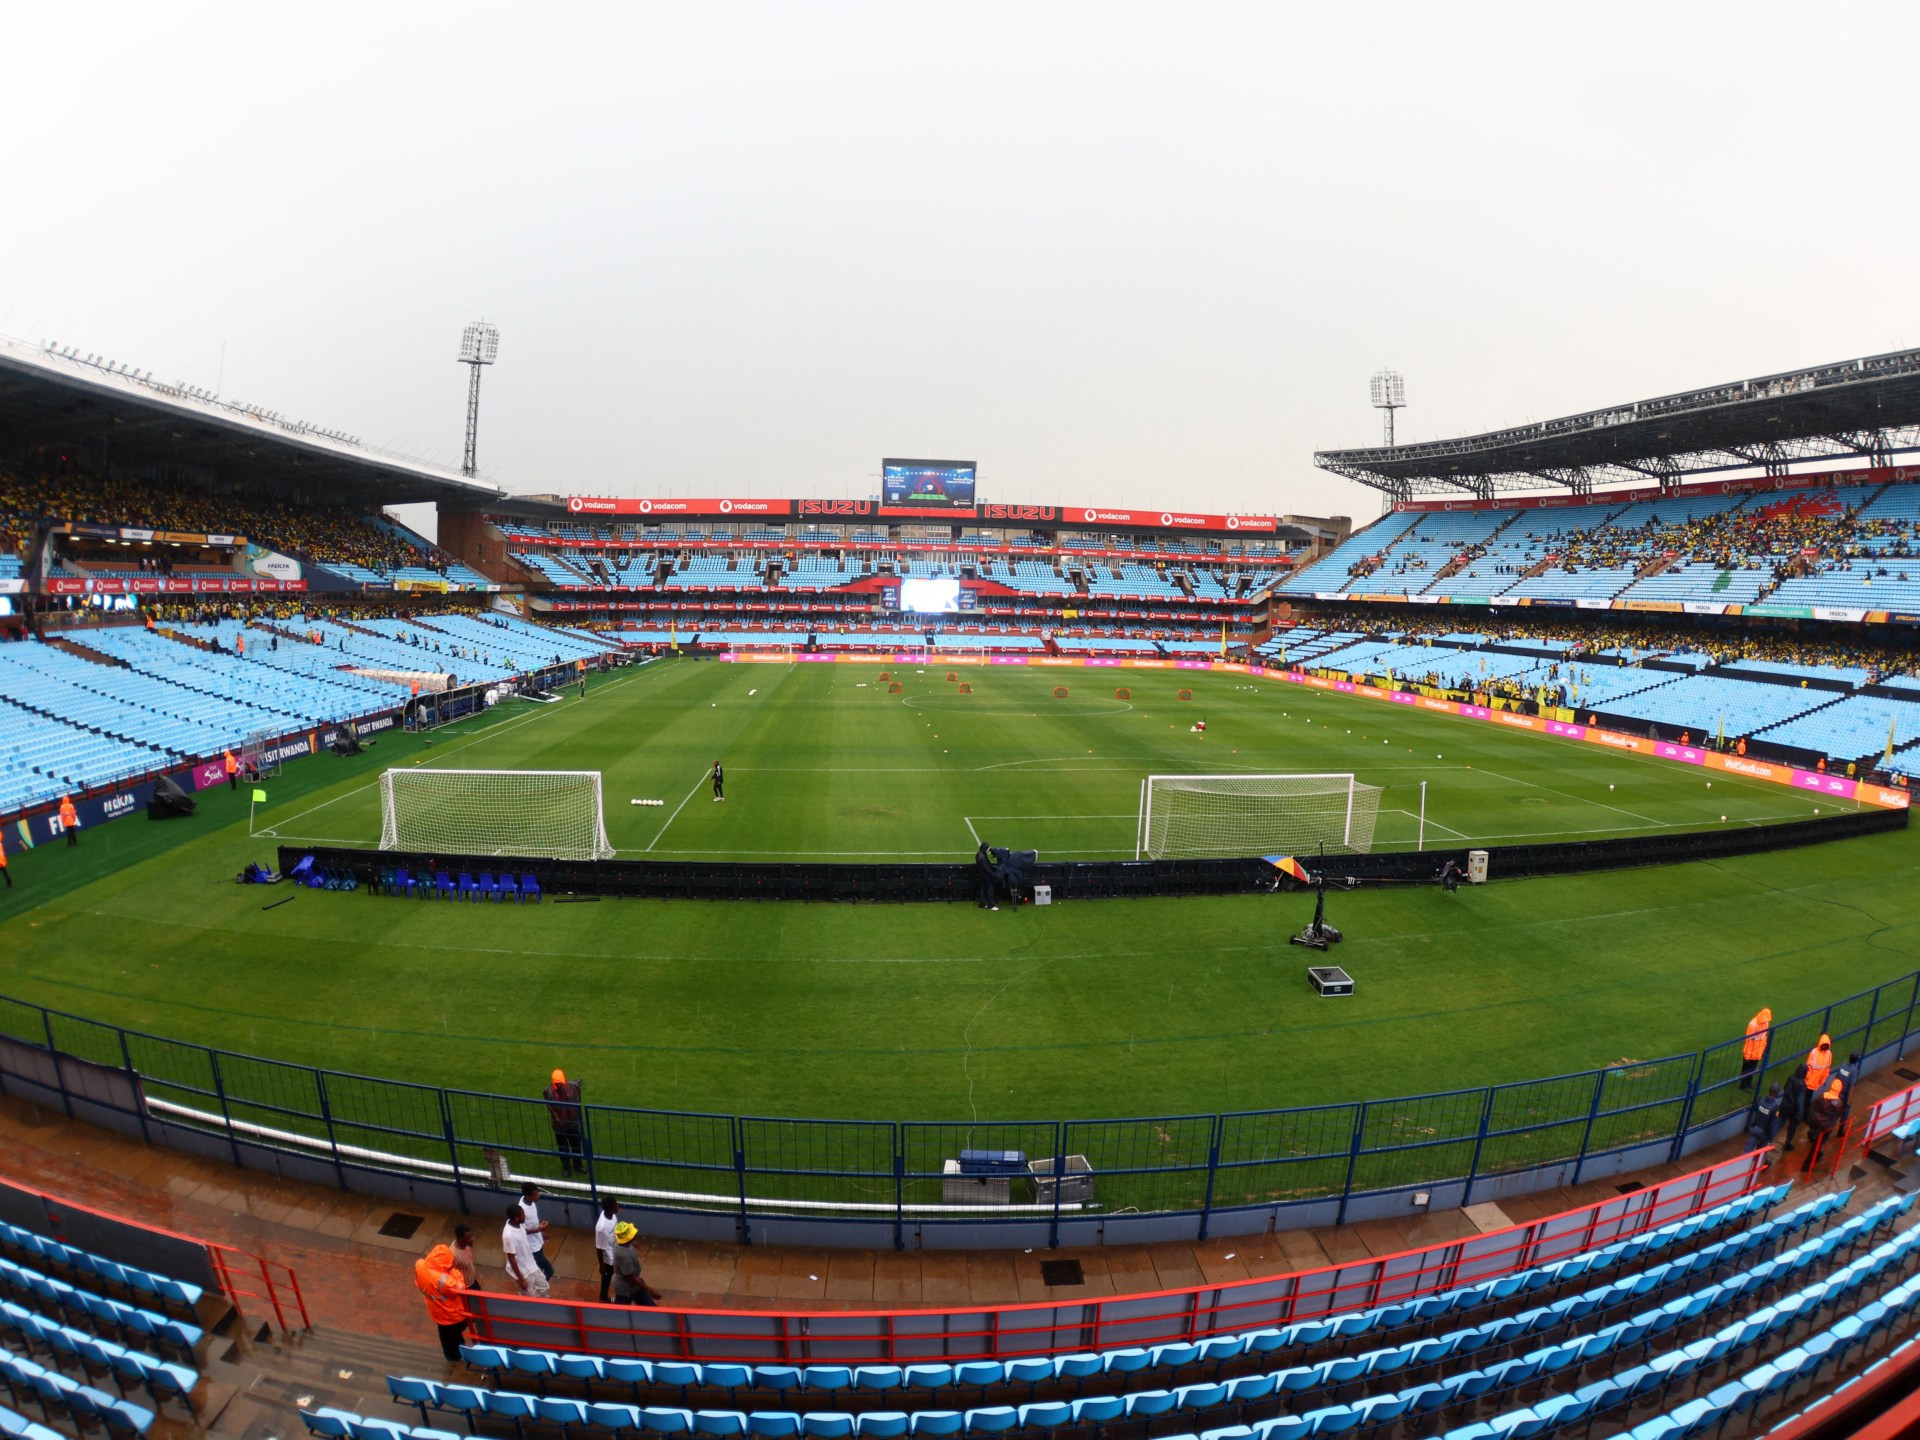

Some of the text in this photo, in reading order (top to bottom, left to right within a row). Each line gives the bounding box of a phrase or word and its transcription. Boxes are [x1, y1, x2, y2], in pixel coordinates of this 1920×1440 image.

[653, 502, 686, 510] vodacom
[733, 502, 768, 510] vodacom
[798, 500, 871, 515] ISUZU
[984, 504, 1055, 520] ISUZU
[1098, 512, 1131, 520] vodacom
[1174, 516, 1205, 525] vodacom
[1240, 519, 1272, 527] vodacom
[357, 716, 393, 735] VISIT RWANDA
[280, 741, 309, 759] RWANDA
[1724, 758, 1772, 776] VisitSaudi.com
[48, 814, 81, 835] FIA
